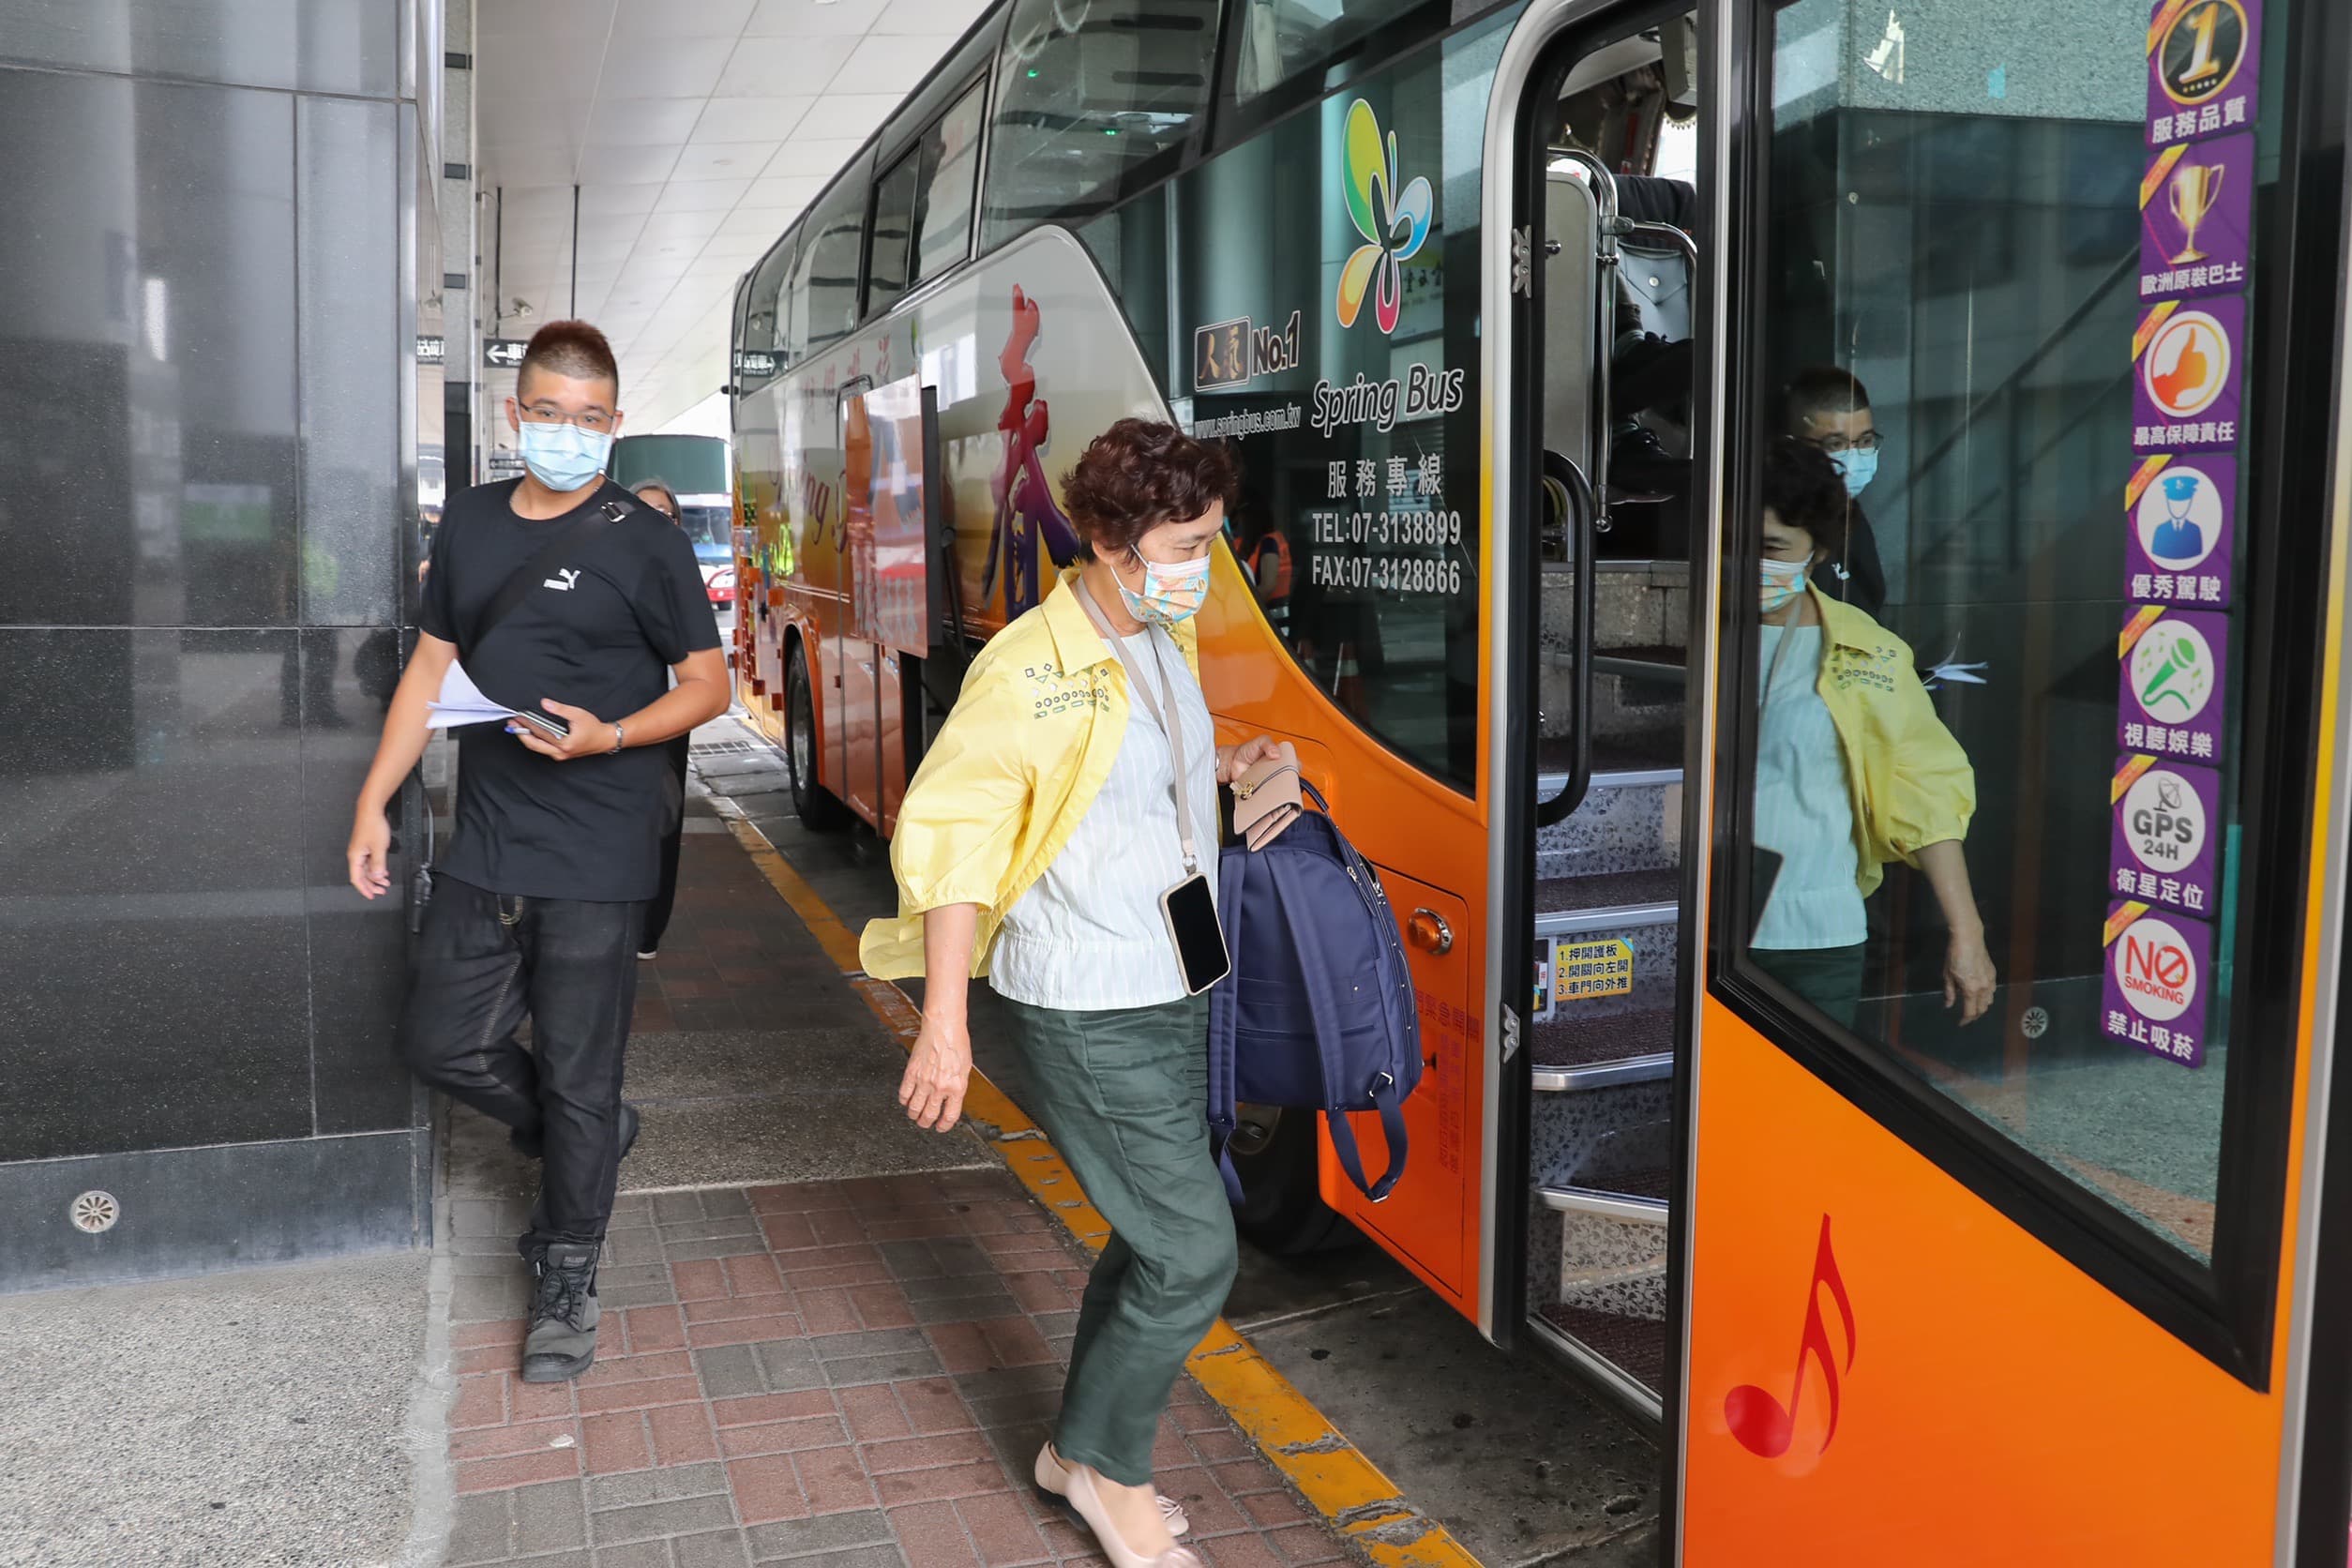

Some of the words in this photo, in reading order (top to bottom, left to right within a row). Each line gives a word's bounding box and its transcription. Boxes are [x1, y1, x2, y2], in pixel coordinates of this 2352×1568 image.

[2151, 96, 2247, 144] 服務品質
[2140, 261, 2243, 295] 歐洲原裝巴士
[1251, 309, 1301, 376] No.1
[1311, 372, 1399, 438] Spring
[1405, 362, 1464, 415] Bus
[1194, 401, 1302, 441] www.springbus.com.tw
[2133, 422, 2235, 446] 最高保障責任
[1327, 453, 1441, 499] 服務專線
[1312, 511, 1461, 546] TEL:07-3138899
[1312, 555, 1461, 594] FAX:07-3128866
[2132, 574, 2221, 602] 優秀駕駛
[2124, 723, 2212, 758] 視聽娛樂
[2133, 809, 2193, 843] GPS
[2144, 839, 2179, 861] 24H
[2116, 867, 2204, 911] 衛星定位
[2124, 975, 2184, 1005] SMOKING
[2107, 1011, 2194, 1061] 禁止吸菸
